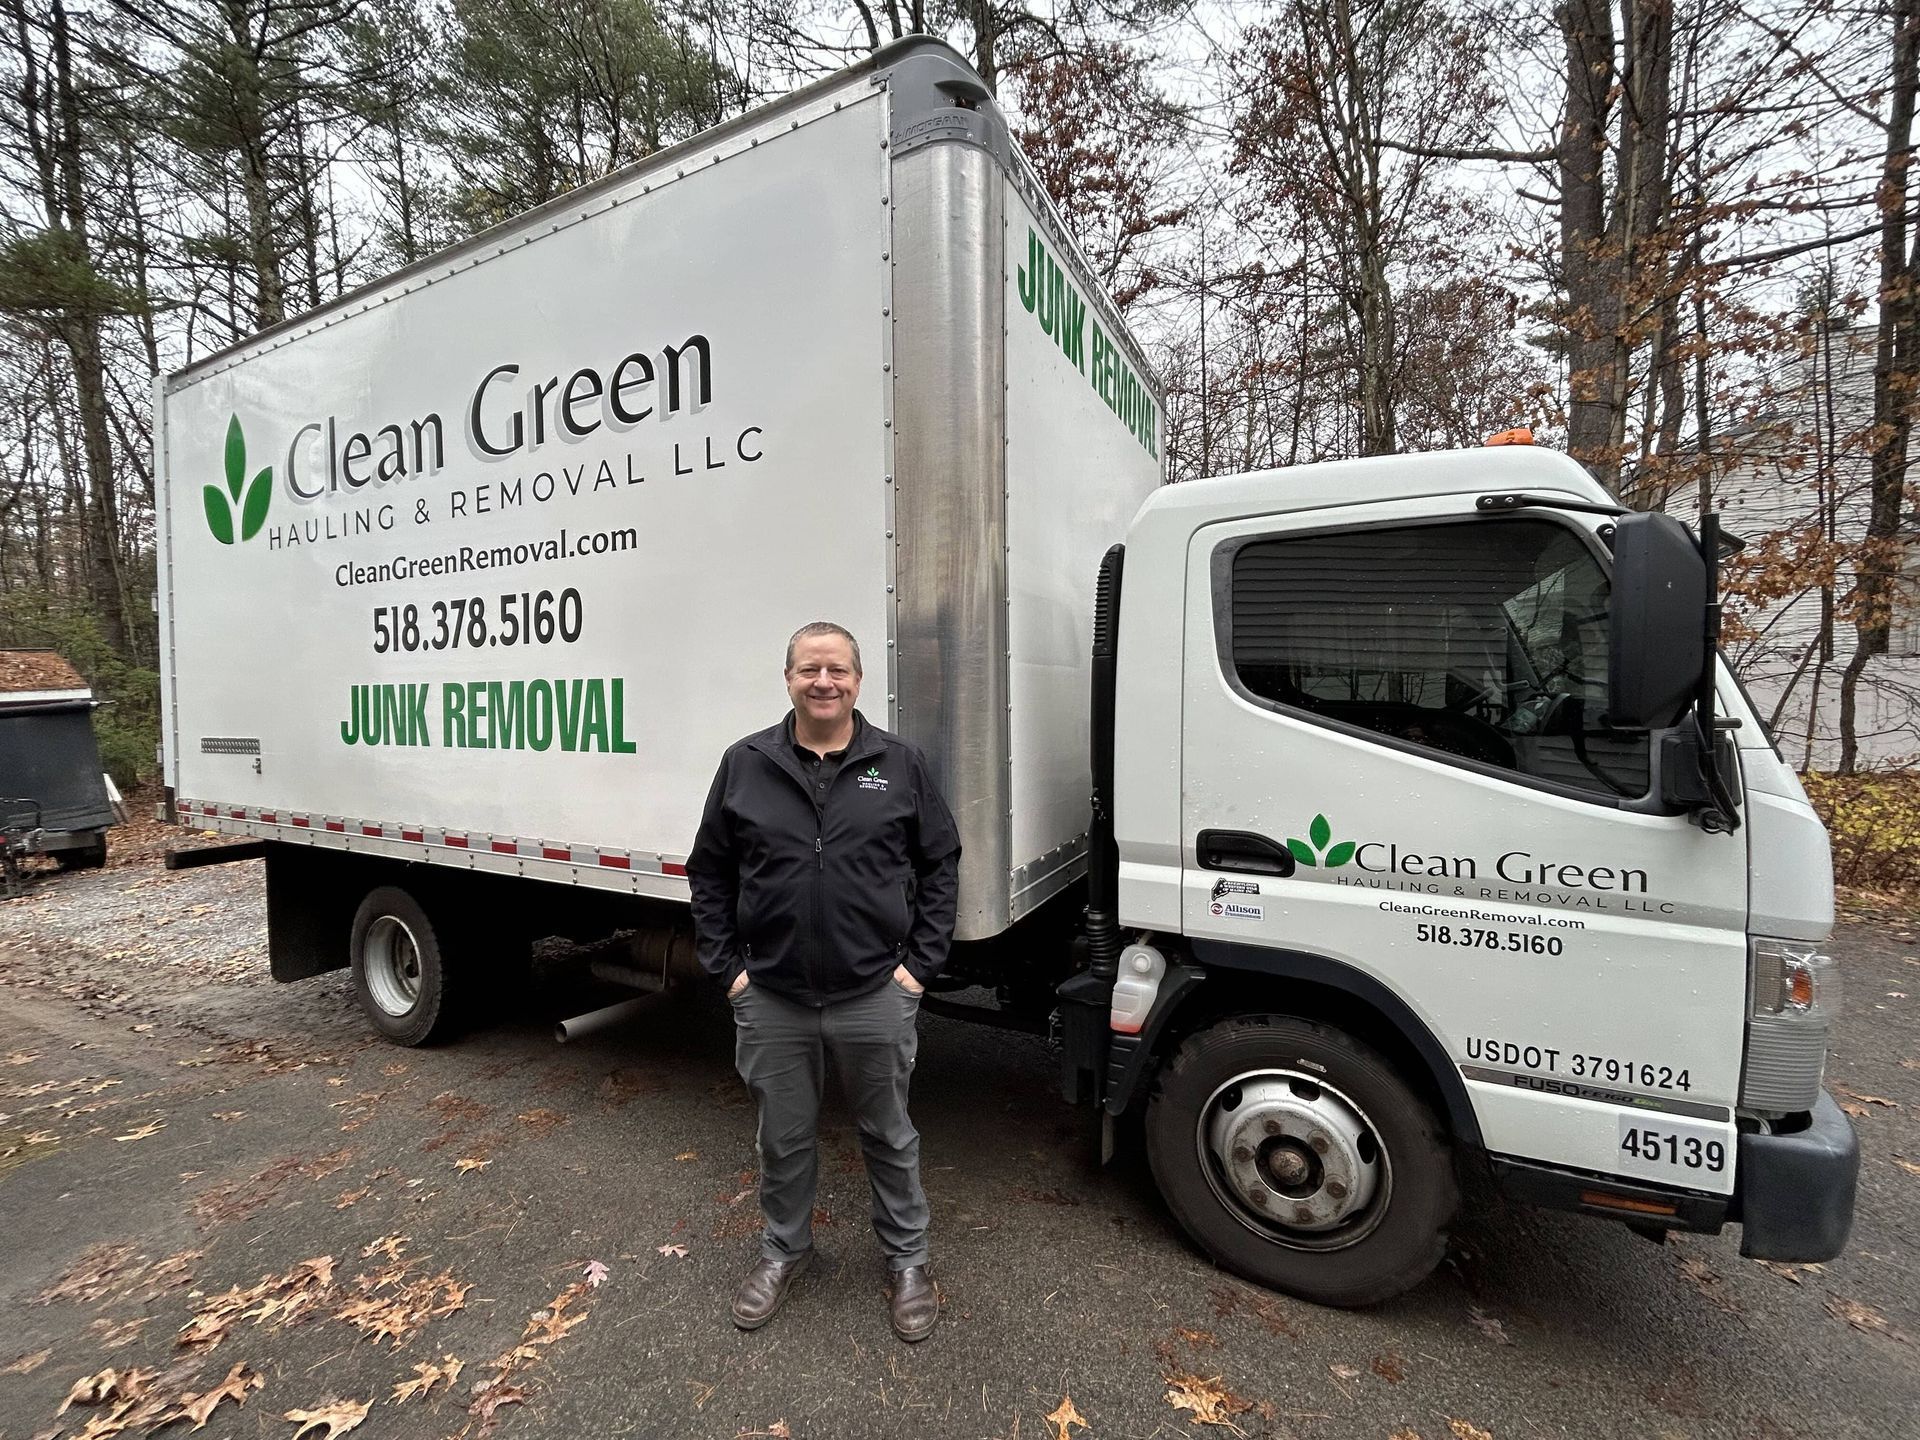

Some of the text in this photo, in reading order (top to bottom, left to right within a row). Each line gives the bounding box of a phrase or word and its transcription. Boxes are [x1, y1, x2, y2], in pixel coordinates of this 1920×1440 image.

[1017, 225, 1159, 462] JUNK REMOVAL
[286, 334, 712, 499] Clean Green
[269, 426, 763, 551] HAULING & REMOVAL LLC
[335, 528, 638, 587] CleanGreenRemoval.com
[373, 587, 583, 654] 518.378.5160
[340, 677, 637, 755] JUNK REMOVAL
[1355, 842, 1648, 893] Clean Green
[1225, 904, 1261, 914] Allison
[1336, 875, 1676, 914] HAULING & REMOVAL LLC
[1379, 901, 1586, 930] CleanGreenRemoval.com
[1416, 923, 1563, 957] 518.378.5160
[1466, 1036, 1691, 1092] USDOT 3791624
[1514, 1075, 1580, 1096] FUSO
[1621, 1128, 1725, 1172] 45139
